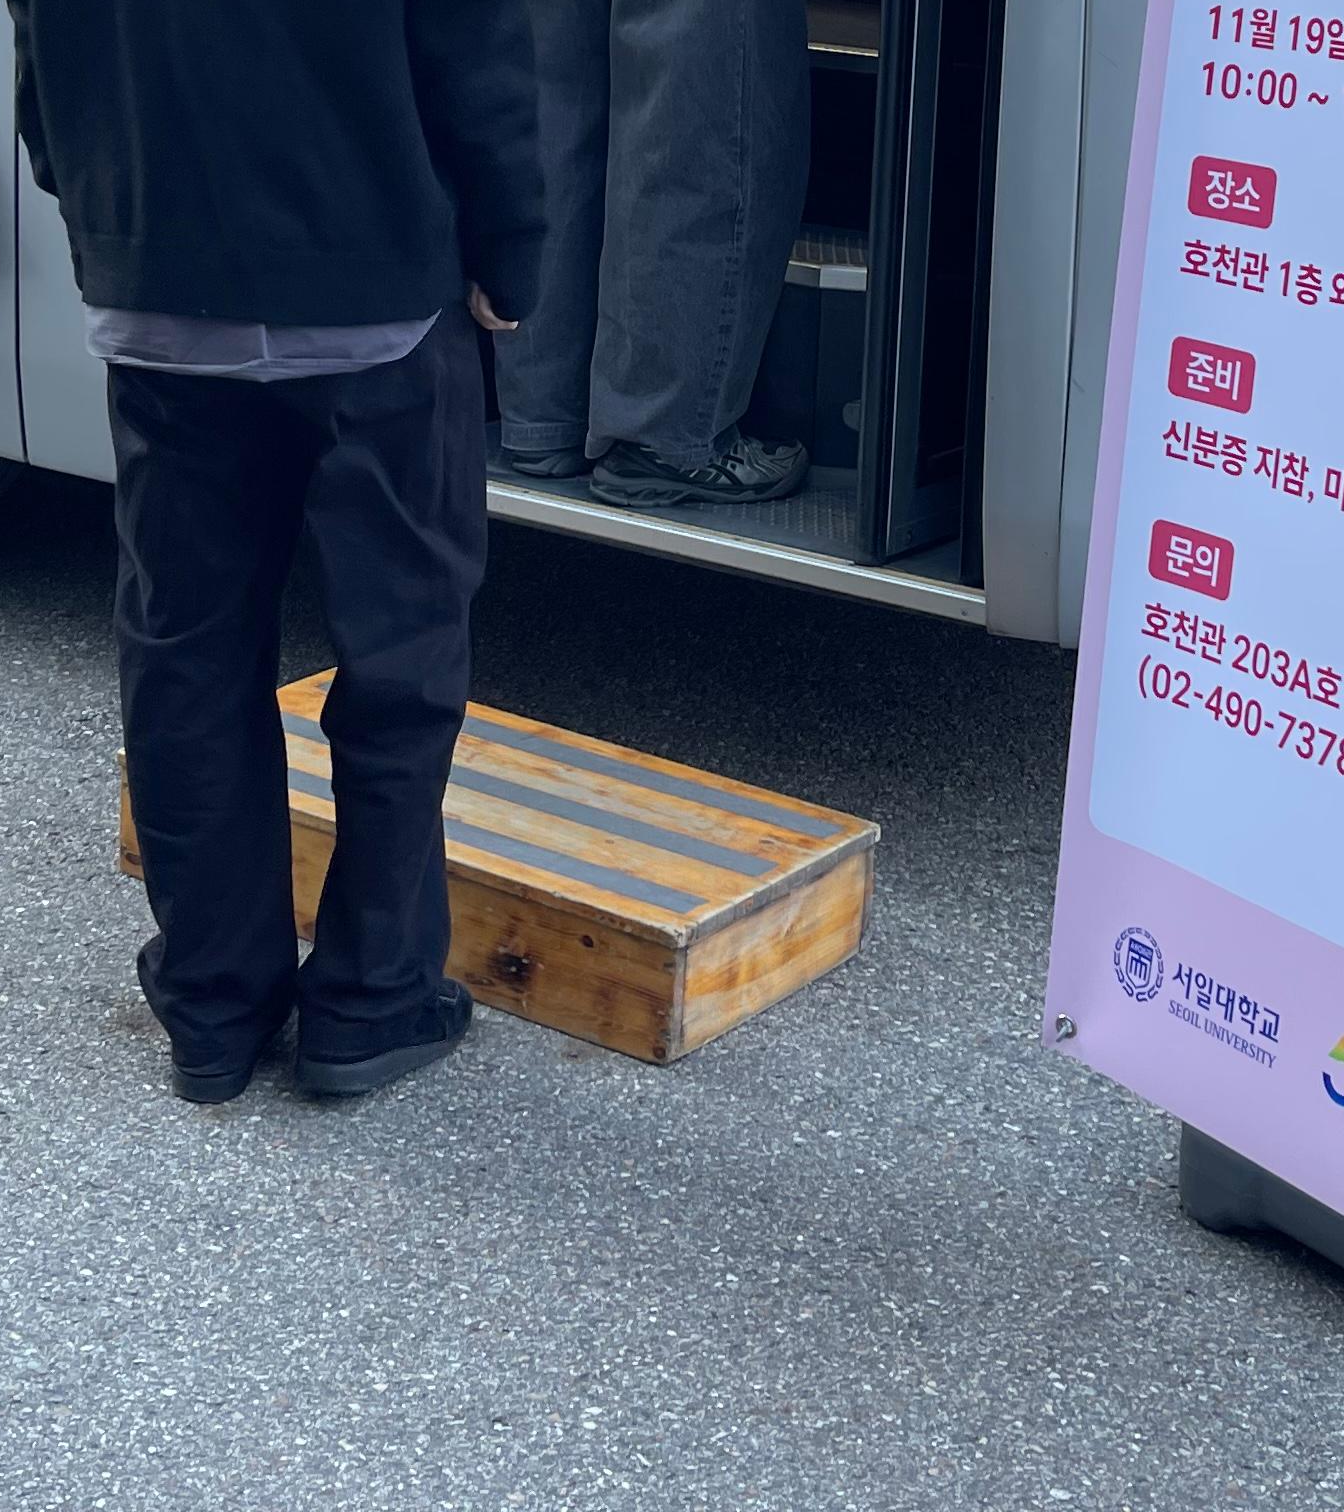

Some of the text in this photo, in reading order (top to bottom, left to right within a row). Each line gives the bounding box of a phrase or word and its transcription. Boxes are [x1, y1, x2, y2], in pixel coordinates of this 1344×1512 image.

[1208, 4, 1278, 50] 11월
[1202, 61, 1298, 109] 10:00
[1307, 90, 1329, 106] ~
[1204, 169, 1262, 213] 장소
[1180, 239, 1270, 293] 호천관
[1278, 260, 1323, 306] 1층
[1185, 351, 1243, 401] 준비
[1162, 420, 1248, 477] 신분증
[1253, 444, 1315, 503] 지참,
[1165, 534, 1221, 587] 문의
[1141, 602, 1227, 664] 호천관
[1231, 634, 1343, 710] 203A호
[1171, 962, 1281, 1044] 서일대학교
[1167, 999, 1278, 1069] SEOIL UNIVERSITY
